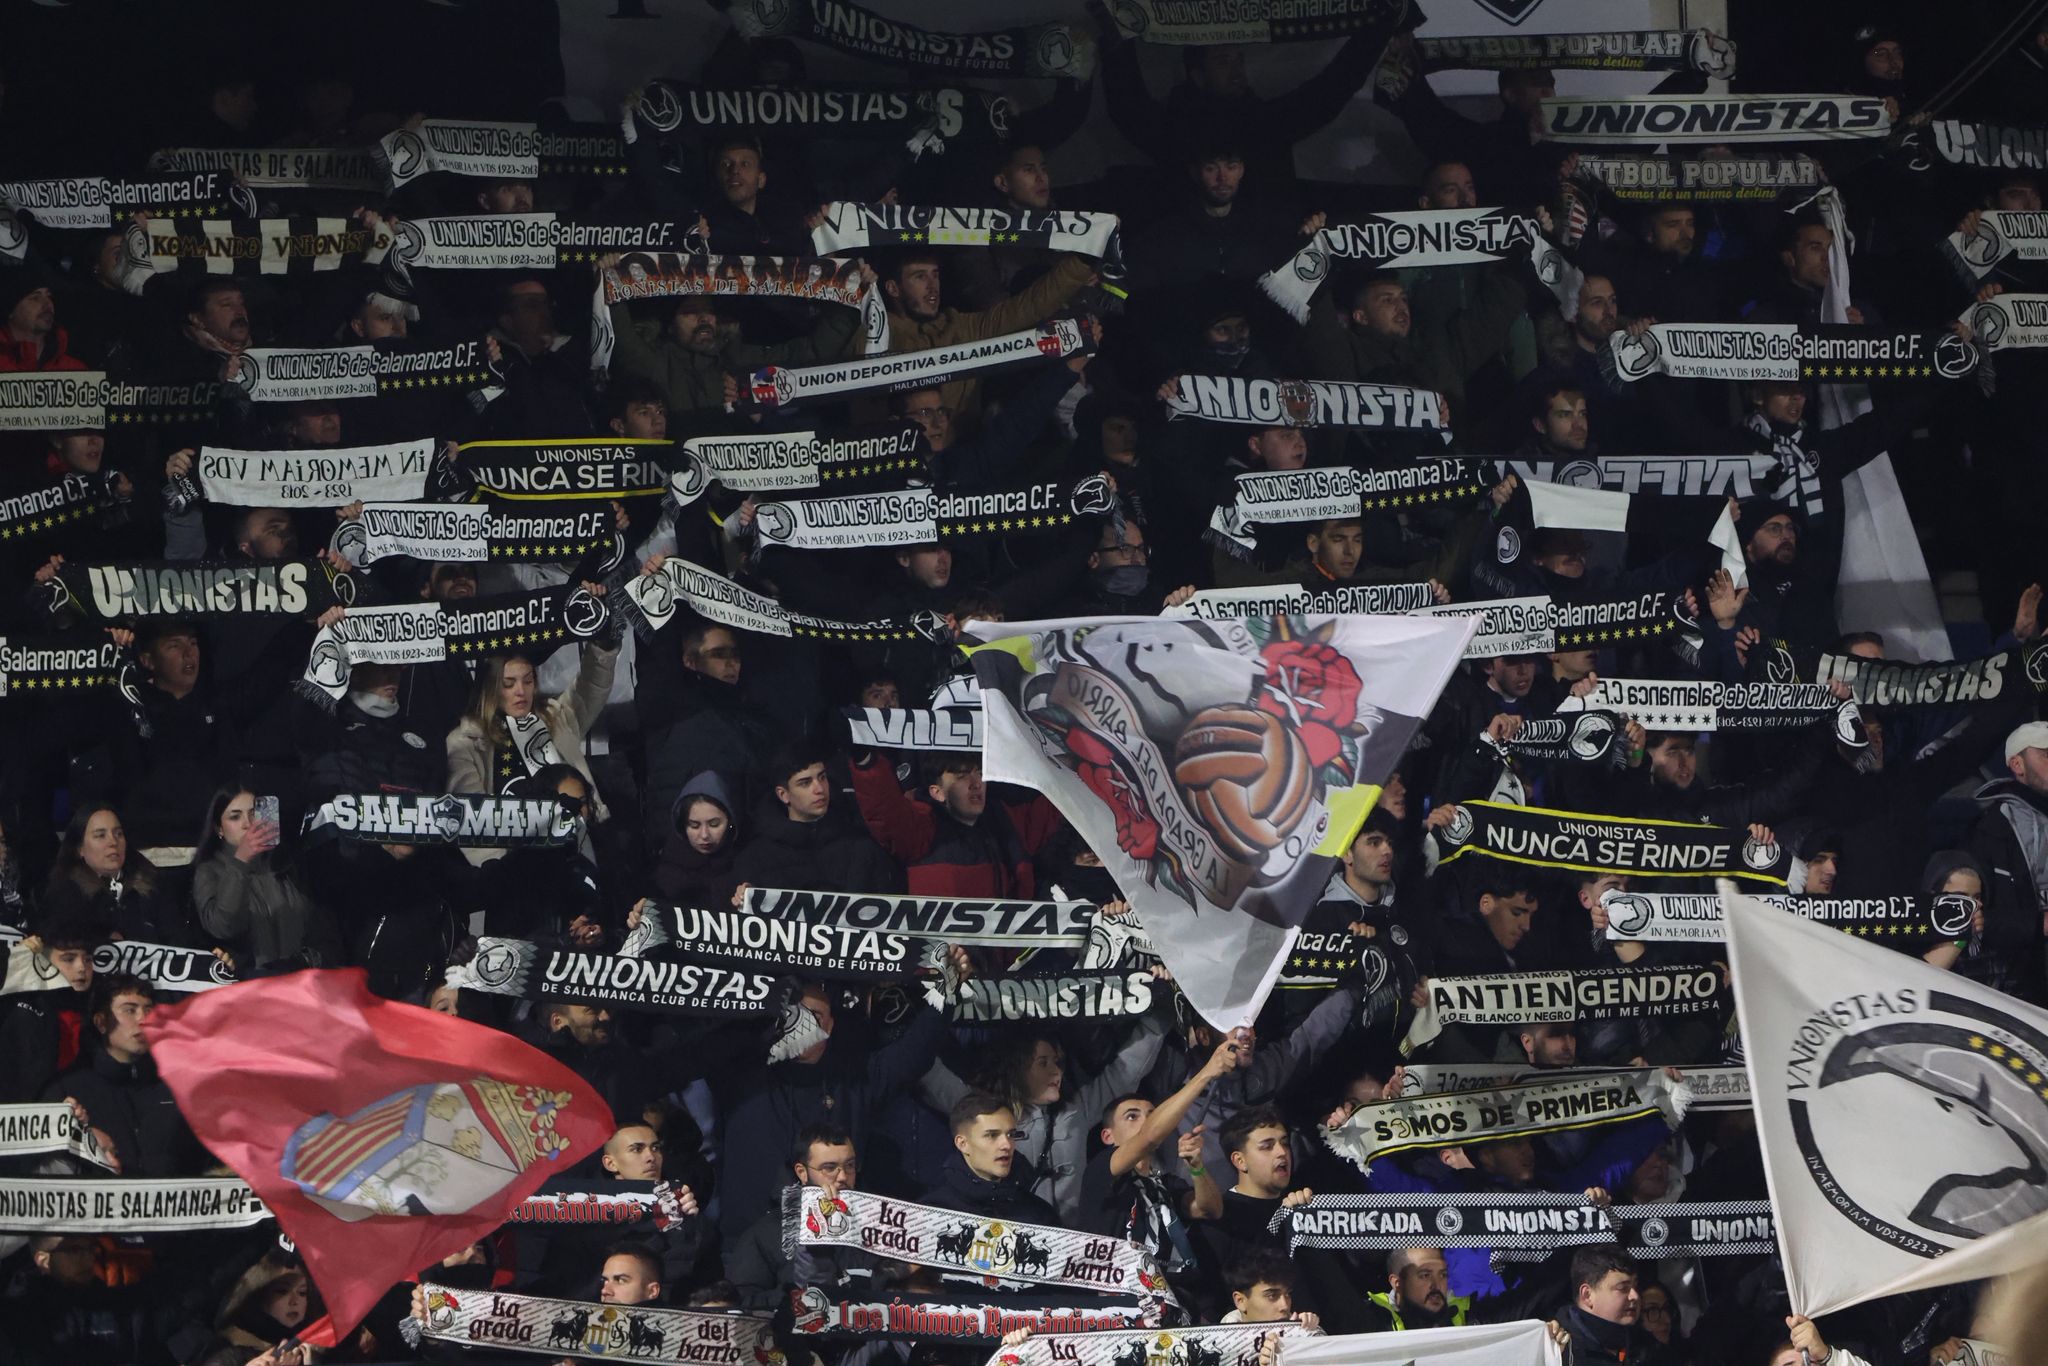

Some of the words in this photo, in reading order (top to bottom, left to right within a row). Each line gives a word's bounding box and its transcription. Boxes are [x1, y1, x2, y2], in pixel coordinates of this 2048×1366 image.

[1546, 33, 1683, 57] POPULAR
[690, 88, 907, 125] UNIONISTAS
[1551, 101, 1882, 134] UNIONISTAS
[425, 126, 511, 157] UNIONISTAS
[512, 134, 532, 157] de
[533, 133, 617, 158] Salamanca
[1683, 160, 1818, 187] POPULAR
[80, 183, 100, 205] de
[101, 180, 190, 206] Salamanca
[194, 174, 221, 200] C.F.
[152, 234, 263, 258] KOMANDO
[429, 221, 527, 249] UNIONISTAS
[528, 224, 549, 248] de
[550, 222, 641, 248] Salamanca
[646, 222, 674, 247] C.F.
[1319, 216, 1530, 259] UNIONISTA
[266, 351, 348, 380] UNIONISTAS
[349, 355, 369, 377] de
[370, 347, 453, 376] Salamanca
[455, 341, 480, 368] C.F.
[1666, 330, 1767, 359] UNIONISTAS
[1768, 334, 1791, 359] de
[1792, 335, 1891, 359] Salamanca
[1894, 335, 1923, 359] C.F.
[799, 370, 847, 388] UNION
[849, 357, 936, 384] DEPORTIVA
[938, 337, 1035, 368] SALAMANCA
[0, 380, 76, 408] NIONISTAS
[78, 383, 98, 408] de
[99, 380, 188, 407] Salamanca
[535, 447, 636, 464] UNIONISTAS
[700, 441, 788, 471] UNIONISTAS
[789, 442, 809, 466] de
[809, 436, 898, 466] Salamanca
[576, 466, 614, 488] SE
[1240, 474, 1329, 503] UNIONISTAS
[1331, 473, 1352, 498] de
[1352, 463, 1440, 496] Salamanca
[1442, 460, 1468, 483] C.F.
[802, 499, 900, 528] UNIONISTAS
[901, 499, 927, 522] de
[928, 490, 1026, 519] Salamanca
[1030, 484, 1062, 510] C.F.
[364, 510, 459, 539] UNIONISTAS
[460, 513, 480, 539] de
[481, 512, 575, 541] Salamanca
[88, 561, 308, 618] UNIONISTAS
[672, 562, 759, 613] UNIONISTAS
[417, 614, 437, 640] de
[438, 604, 525, 638] Salamanca
[528, 597, 554, 624] C.F.
[1527, 606, 1547, 632] de
[1548, 600, 1636, 633] Salamanca
[1639, 592, 1665, 619] C.F.
[334, 794, 577, 838] SALAMANC
[1558, 822, 1657, 842] UNIONISTAS
[1487, 823, 1589, 862] NUNCA
[1597, 841, 1634, 866] SE
[1641, 842, 1730, 868] RINDE
[1890, 896, 1920, 920] C.F.
[674, 906, 910, 961] UNIONISTAS
[676, 940, 692, 952] DE
[697, 943, 782, 963] SALAMANCA
[787, 954, 822, 968] CLUB
[828, 958, 845, 969] DE
[849, 957, 903, 972] FÚTBOL
[544, 951, 776, 1001] UNIONISTAS
[541, 982, 558, 993] DE
[563, 982, 646, 1004] SALAMANCA
[651, 994, 687, 1006] CLUB
[691, 997, 709, 1008] DE
[713, 996, 767, 1010] FÚTBOL
[1459, 1013, 1472, 1024] EL
[1475, 1012, 1522, 1023] BLANCO
[1525, 1011, 1533, 1022] Y
[1534, 1010, 1572, 1022] NEGRO
[1578, 1009, 1587, 1020] A
[1594, 1007, 1612, 1018] MI
[1619, 1005, 1640, 1017] ME
[1647, 1000, 1720, 1016] INTERESA
[1479, 1103, 1514, 1130] DE
[0, 1189, 87, 1220] NIONISTAS
[95, 1191, 115, 1219] DE
[121, 1189, 221, 1219] SALAMANCA
[227, 1187, 251, 1216] CF
[1806, 1153, 1822, 1171] IN
[1817, 1169, 1872, 1228] MEMORIAM
[1873, 1221, 1899, 1241] VDS
[1484, 1206, 1613, 1234] UNIONISTA
[861, 1223, 921, 1256] grada
[1084, 1238, 1116, 1264] del
[1062, 1256, 1126, 1285] barrio
[468, 1313, 534, 1343] grada
[699, 1318, 730, 1342] del
[840, 1300, 884, 1332] Los
[677, 1340, 742, 1364] barrio
